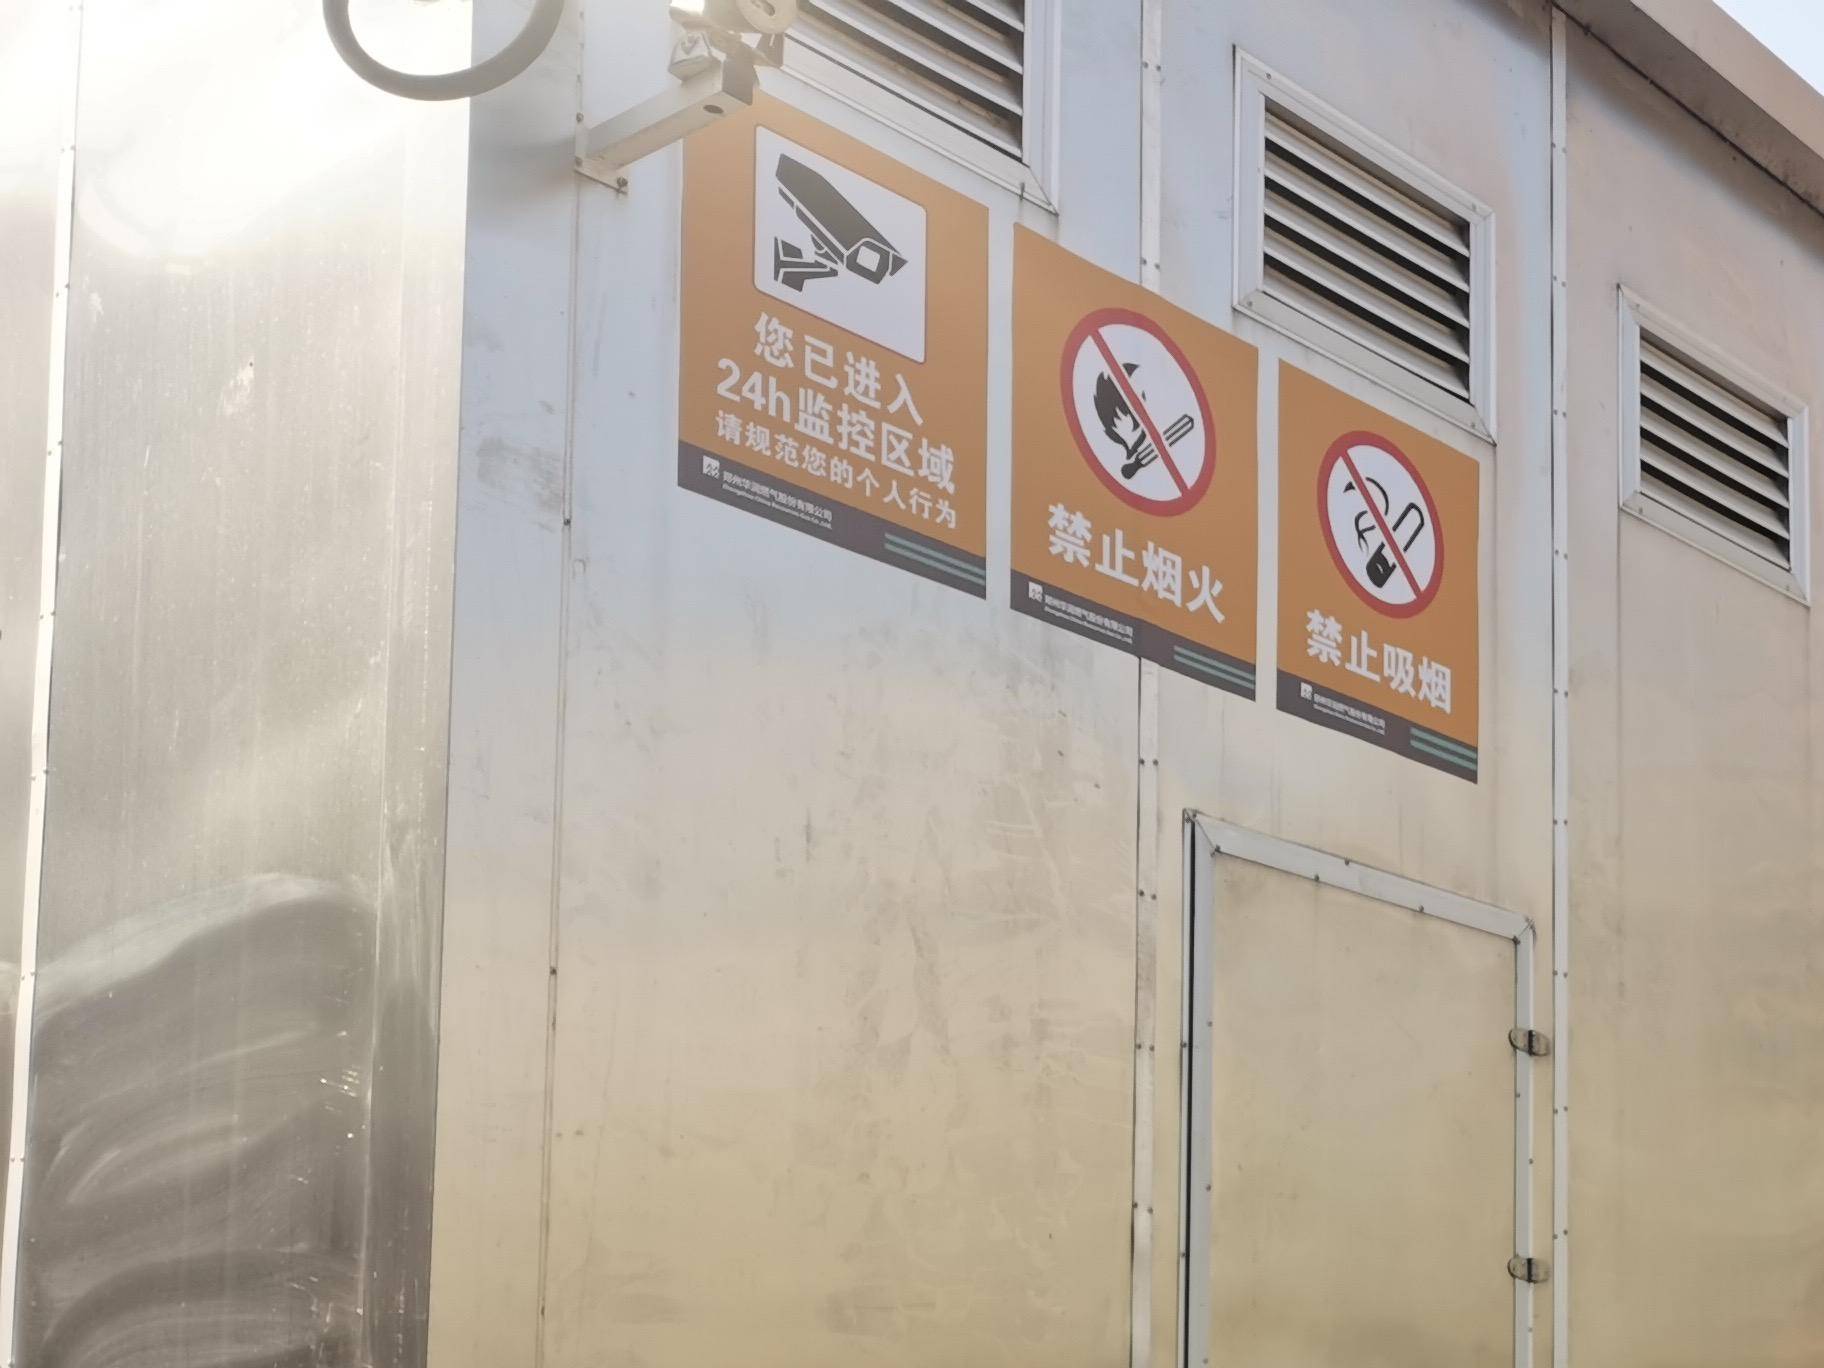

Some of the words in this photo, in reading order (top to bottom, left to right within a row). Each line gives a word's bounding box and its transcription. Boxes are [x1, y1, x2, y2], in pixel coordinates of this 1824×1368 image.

[716, 358, 956, 494] 24h监控区域
[754, 311, 924, 427] 您已进入
[714, 410, 957, 530] 请规范您的个人行为
[1048, 503, 1226, 623] 禁止烟火
[1306, 609, 1452, 714] 禁止吸烟
